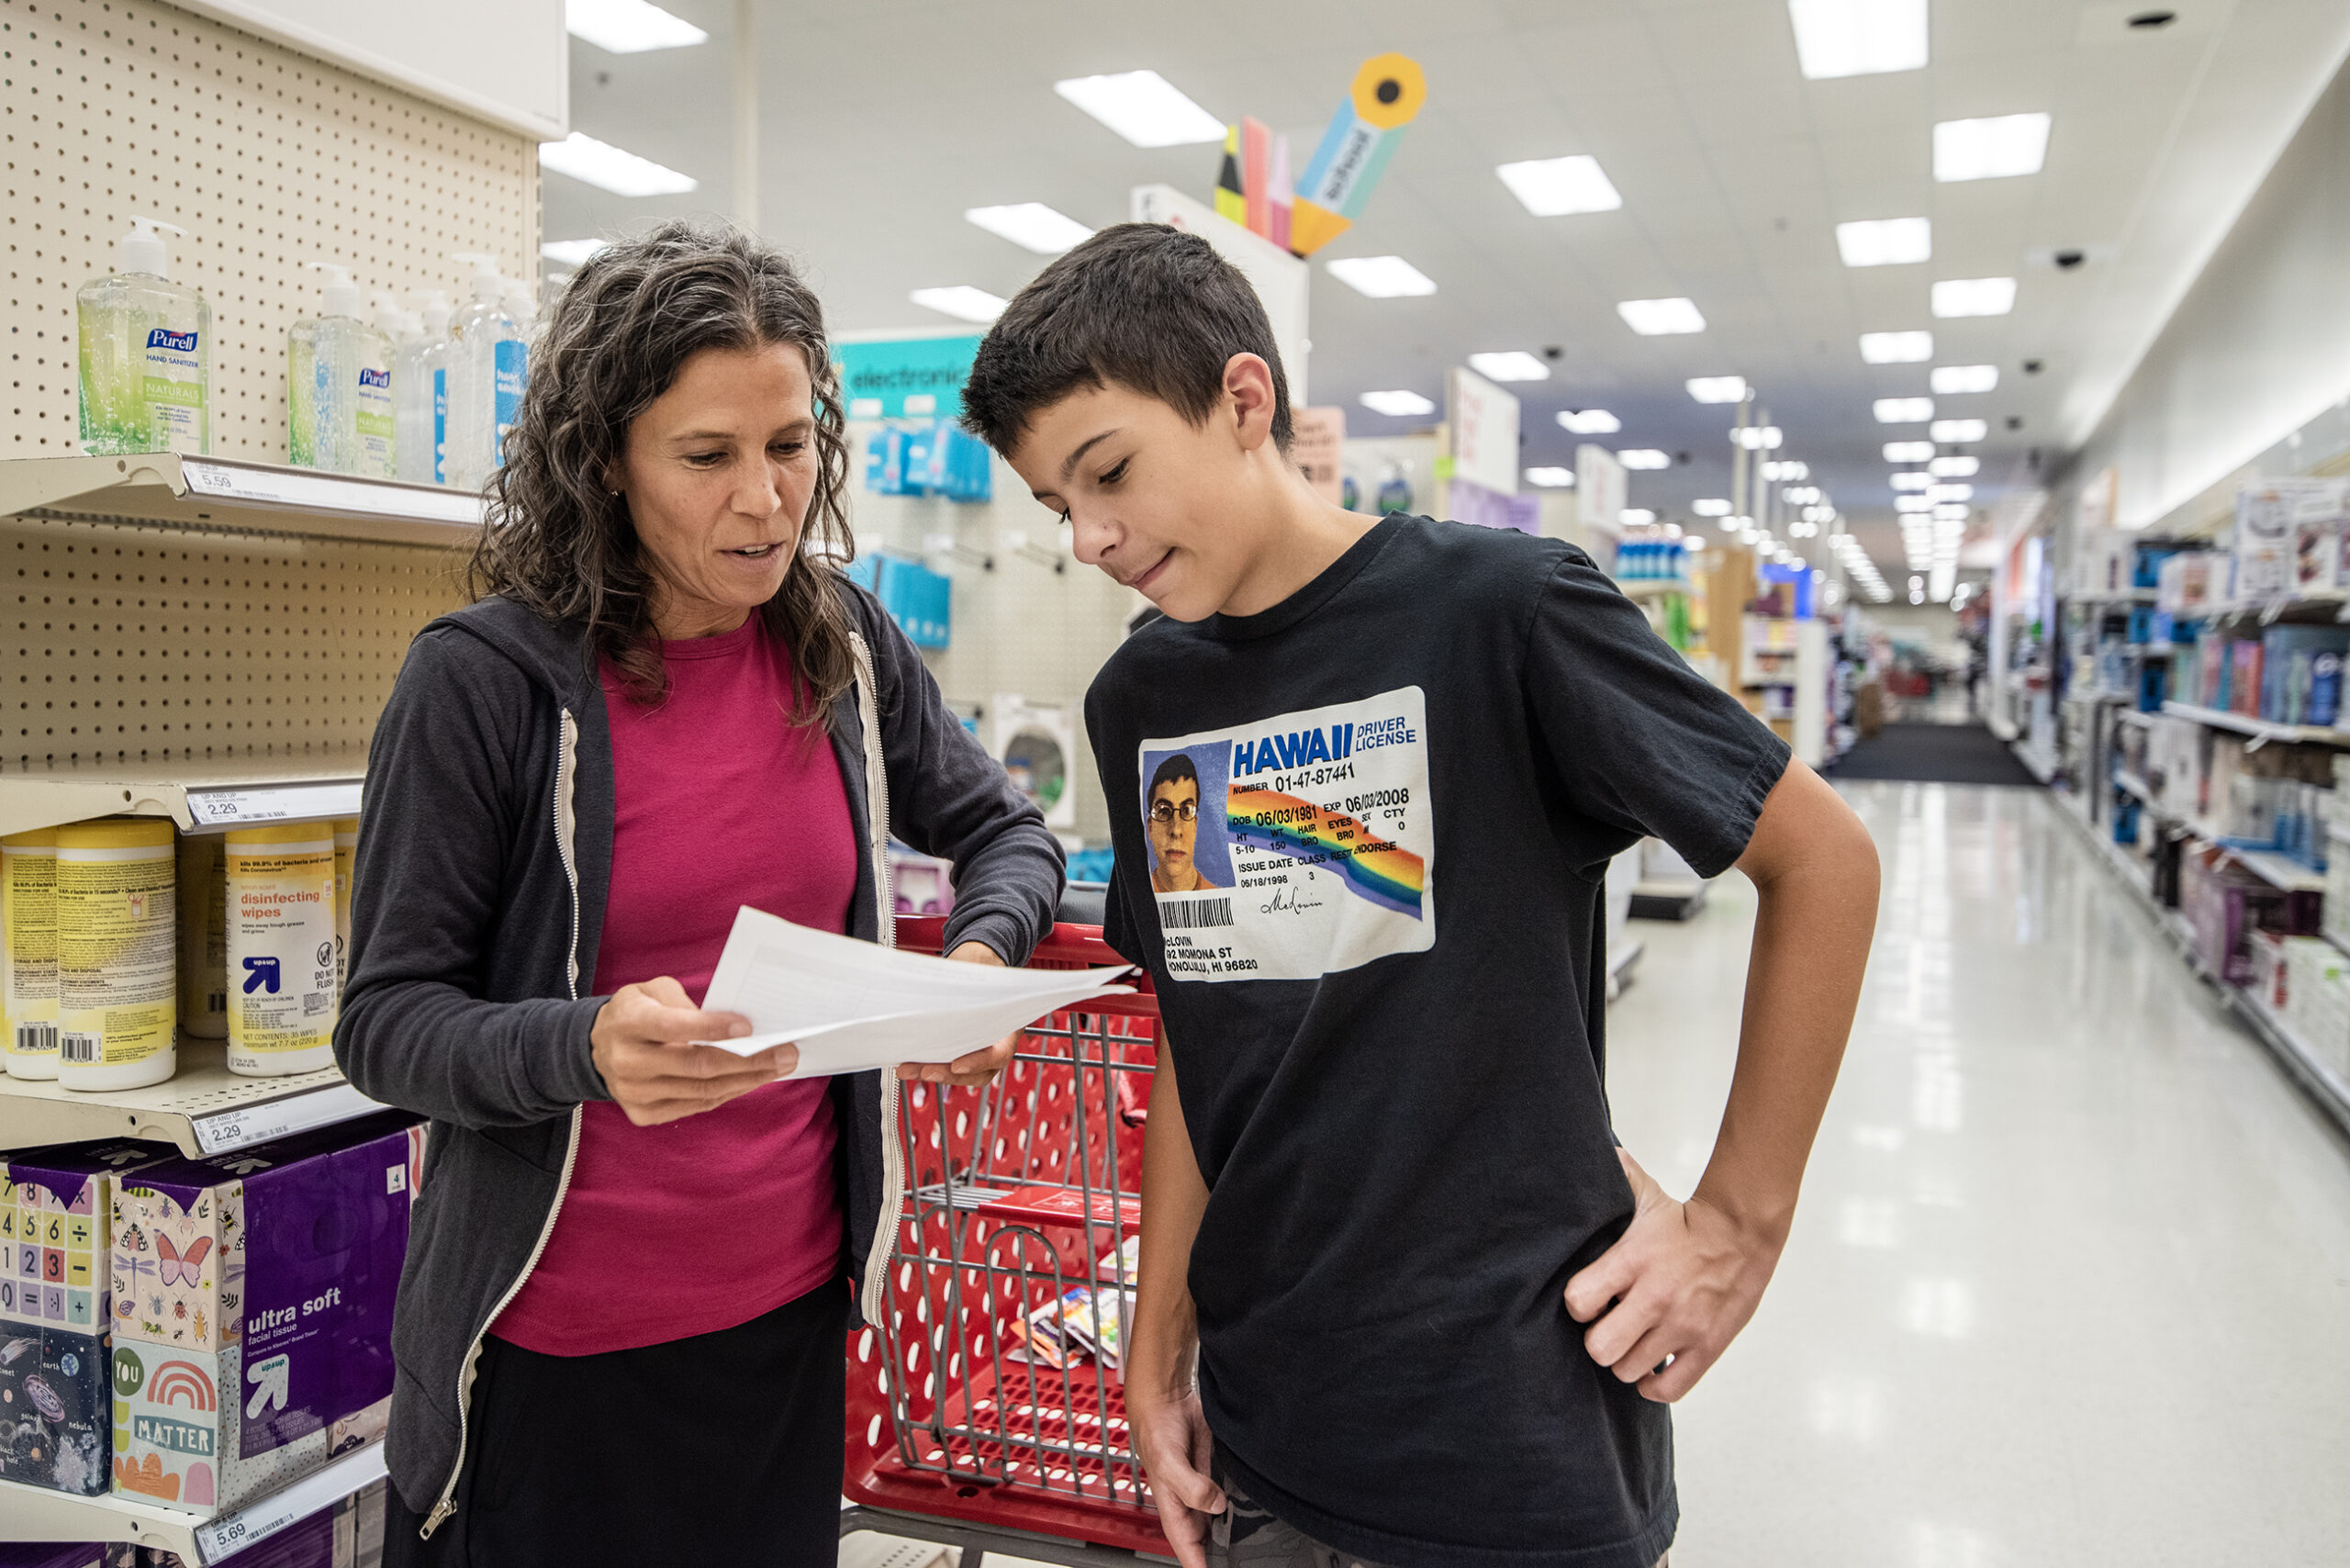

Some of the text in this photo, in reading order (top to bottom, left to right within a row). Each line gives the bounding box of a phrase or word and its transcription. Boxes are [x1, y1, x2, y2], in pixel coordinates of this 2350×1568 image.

[152, 330, 195, 350] Purell
[146, 354, 199, 368] HAND SANITIZER
[364, 369, 389, 386] Purell
[852, 362, 969, 389] electronic
[146, 384, 199, 400] NATURALS
[202, 475, 232, 488] 5.59
[1234, 716, 1405, 778] HAWAII DRIVER
[1356, 730, 1416, 752] LICENSE
[1233, 763, 1355, 795] NUMBER 01-47-87441
[207, 803, 238, 815] 2.29
[1233, 788, 1409, 826] DOB 06/03/1981 EXP 06/03/2008
[1237, 833, 1248, 842] HT
[1270, 828, 1283, 837] WT
[1297, 823, 1317, 834] HAIR
[1327, 817, 1352, 829] EYES
[1383, 808, 1405, 818] CTY
[1236, 845, 1255, 855] 5-10
[1270, 841, 1285, 851] 150
[1301, 836, 1319, 846] BRO
[1337, 830, 1354, 841] BRO
[1238, 861, 1266, 873] ISSUE
[1269, 857, 1293, 869] DATE
[1297, 854, 1326, 866] CLASS
[1354, 841, 1397, 855] ENDORSE
[1241, 871, 1315, 888] 06/18/1998 3
[241, 890, 319, 904] disinfecting
[241, 907, 281, 920] wipes
[1178, 948, 1216, 959] MOMONA
[1218, 946, 1232, 958] ST
[1212, 960, 1223, 972] HI
[1225, 959, 1258, 972] 96820
[315, 971, 324, 980] DO
[254, 1032, 287, 1041] CONTENTS:
[299, 1037, 313, 1046] (220
[212, 1125, 241, 1141] 2.29
[393, 1174, 399, 1182] 4
[27, 1182, 35, 1201] 8
[3, 1212, 12, 1234] 4
[26, 1215, 35, 1236] 5
[50, 1219, 59, 1240] 6
[5, 1247, 59, 1276] 1 2 3
[248, 1287, 341, 1334] ultra soft
[248, 1324, 297, 1346] facial tissue
[247, 1346, 267, 1358] Compare
[291, 1334, 305, 1342] Brand
[42, 1362, 60, 1371] earth
[116, 1361, 139, 1383] YOU
[262, 1359, 285, 1372] up&up
[69, 1422, 93, 1430] nebula
[139, 1420, 209, 1452] MATTER
[6, 1456, 18, 1465] hole
[211, 1519, 221, 1528] UP
[228, 1511, 238, 1519] UP
[217, 1523, 245, 1545] 5.69
